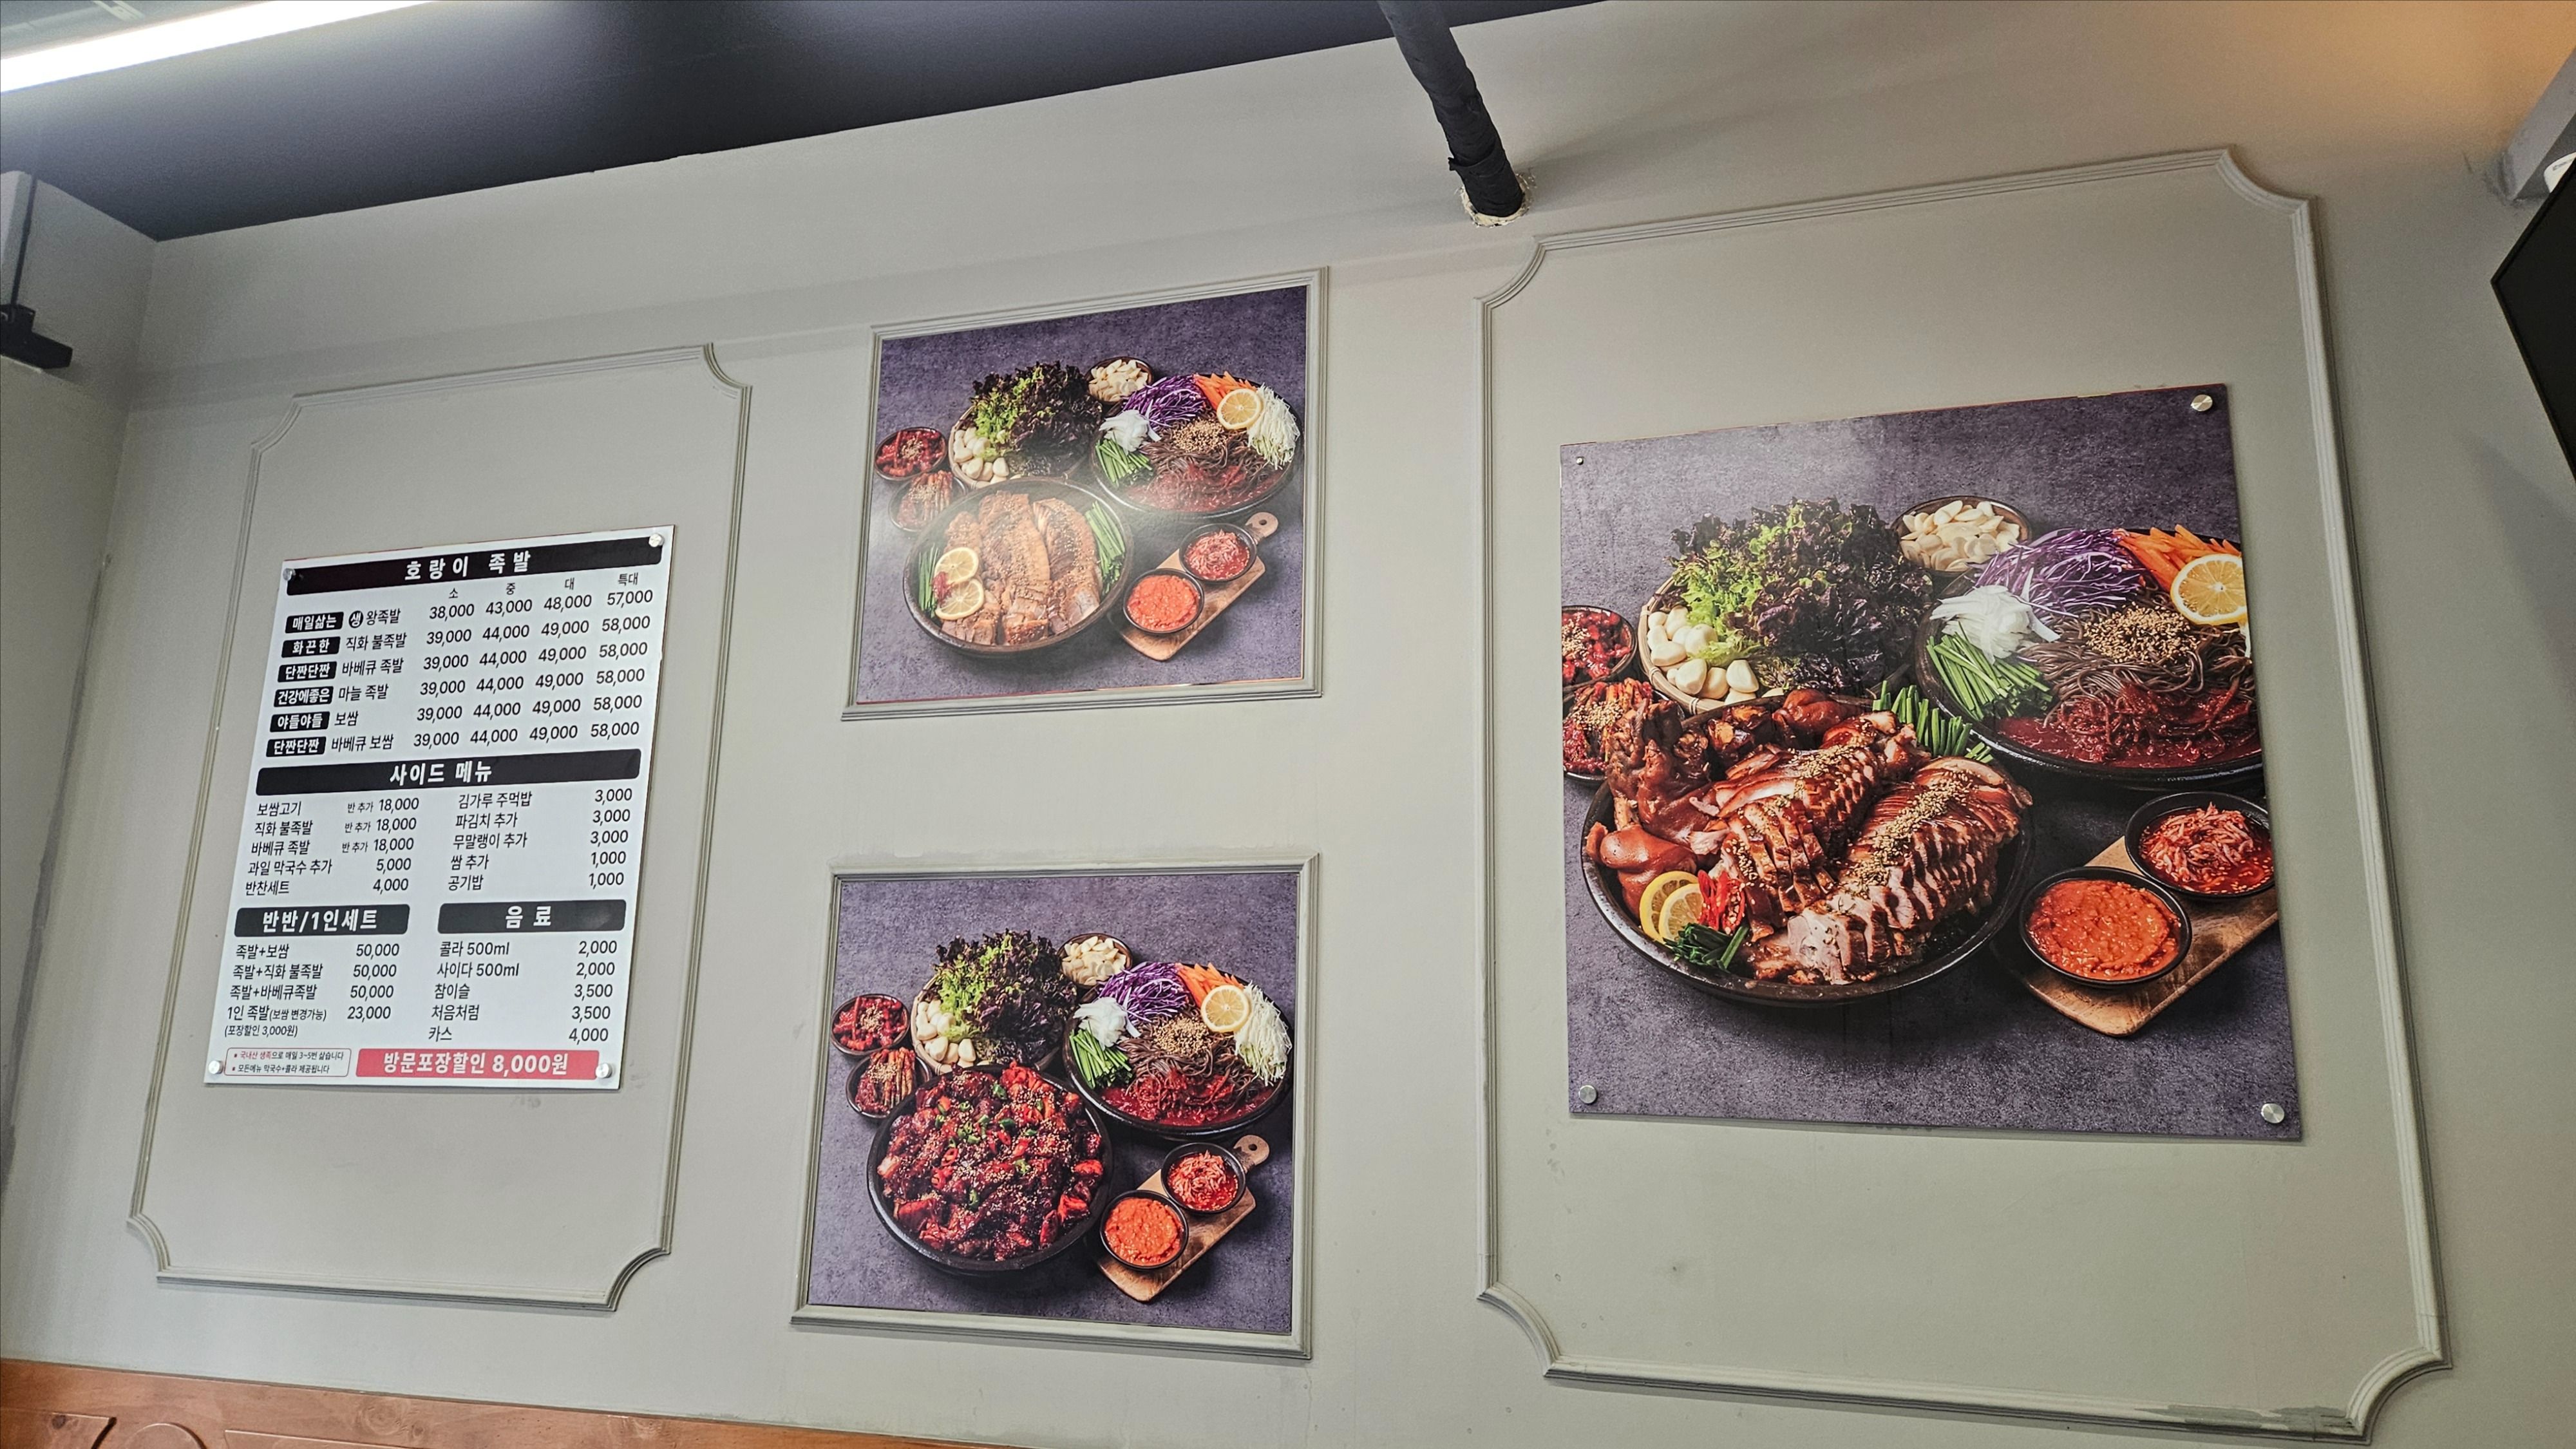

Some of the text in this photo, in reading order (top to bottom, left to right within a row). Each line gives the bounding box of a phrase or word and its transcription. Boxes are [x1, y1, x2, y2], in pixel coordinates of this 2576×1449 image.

[404, 550, 531, 580] 호랑이 족발
[448, 573, 638, 598] 소 중 대 특대
[292, 590, 653, 631] 매일삶는 생 왕족발 38,000 43,000 48,000 57,000
[292, 616, 650, 655] 화끈한 직화 불족발 39,000 44,000 49,000 58,000
[285, 642, 648, 680] 단짠단짠 바베큐 족발 39,000 44,000 49,000 58,000
[278, 668, 645, 705] 건강에좋은 마늘 족발 39,000 44,000 49,000 58,000
[278, 695, 642, 730] 야들야들 보쌈 39,000 44,000 49,000 58,000
[274, 721, 639, 754] 단짠단짠 바베큐 보쌈 39,000 44,000 49,000 58,000
[390, 761, 492, 786] 사이드 메뉴
[257, 798, 419, 817] 보쌈고기 반 추가 18,000
[459, 788, 632, 809] 김가루 주먹밥 3,000
[254, 818, 417, 837] 직화 불족발 반 추가 18,000
[455, 809, 630, 829] 파김치 추가 3,000
[251, 837, 414, 857] 바베큐 족발 반 추가 18,000
[453, 830, 629, 850] 무말랭이 추가 3,000
[247, 858, 412, 876] 과일 막국수 추가 5,000
[451, 851, 626, 870] 쌈 추가 1,000
[245, 878, 408, 896] 반찬세트 4,000
[448, 872, 624, 891] 공기밥 1,000
[263, 909, 377, 933] 반반/1인세트
[236, 943, 399, 960] 족발+보쌈 50,000
[439, 940, 617, 957] 콜라 500ml 2,000
[233, 963, 396, 980] 족발+직화 불족발 50,000
[437, 961, 614, 978] 사이다 500ml 2,000
[230, 984, 393, 1001] 족발+바베큐족발 50,000
[434, 983, 612, 1001] 참이슬 3,500
[227, 1007, 243, 1021] 1인
[347, 1006, 391, 1022] 23,000
[431, 1005, 611, 1023] 처음처럼 3,500
[225, 1025, 298, 1037] (포장할인 3,000원)
[428, 1026, 609, 1045] 카스 4,000
[299, 1065, 329, 1074] 제공됩니다
[384, 1052, 568, 1077] 방문포장할인 8,000원
